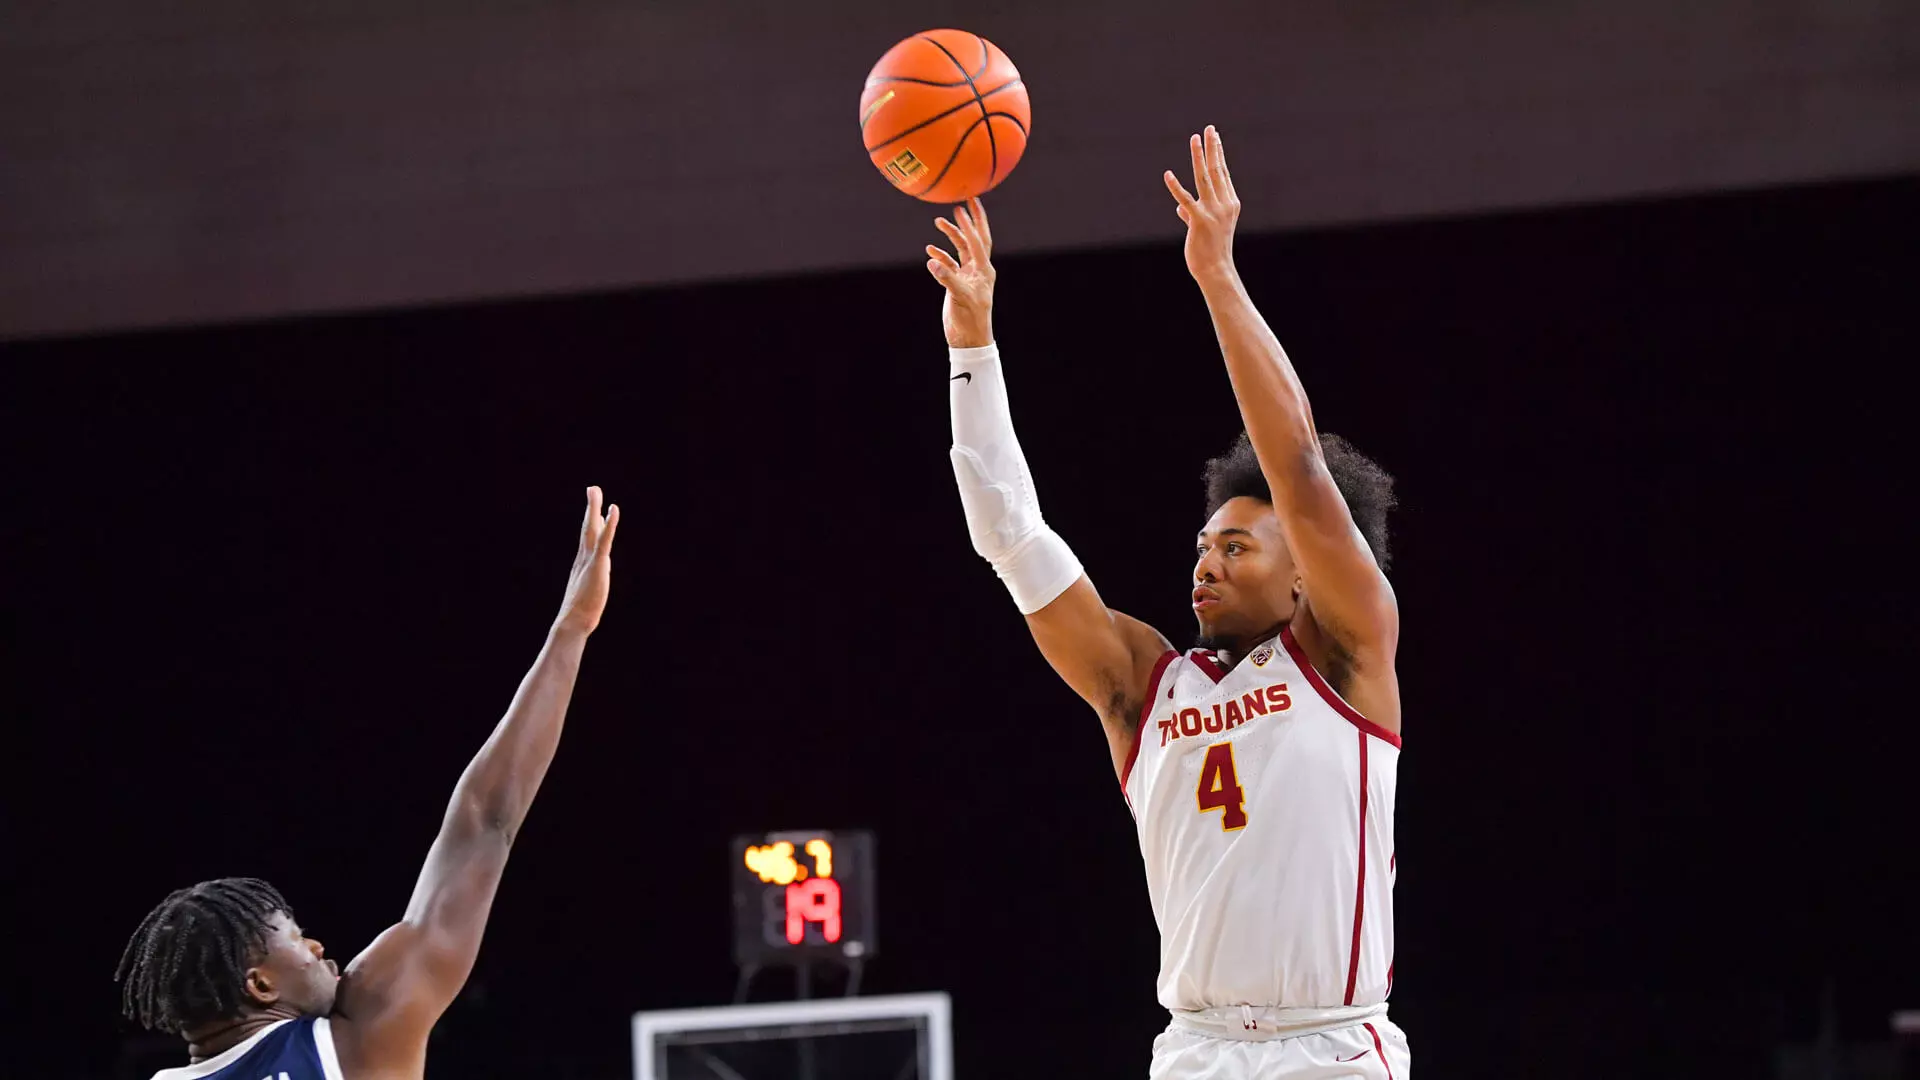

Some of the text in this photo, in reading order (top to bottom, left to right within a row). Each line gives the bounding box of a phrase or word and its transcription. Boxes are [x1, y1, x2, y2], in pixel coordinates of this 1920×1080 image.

[1158, 683, 1292, 747] TROJANS
[1197, 742, 1248, 832] 4
[786, 877, 842, 945] 19
